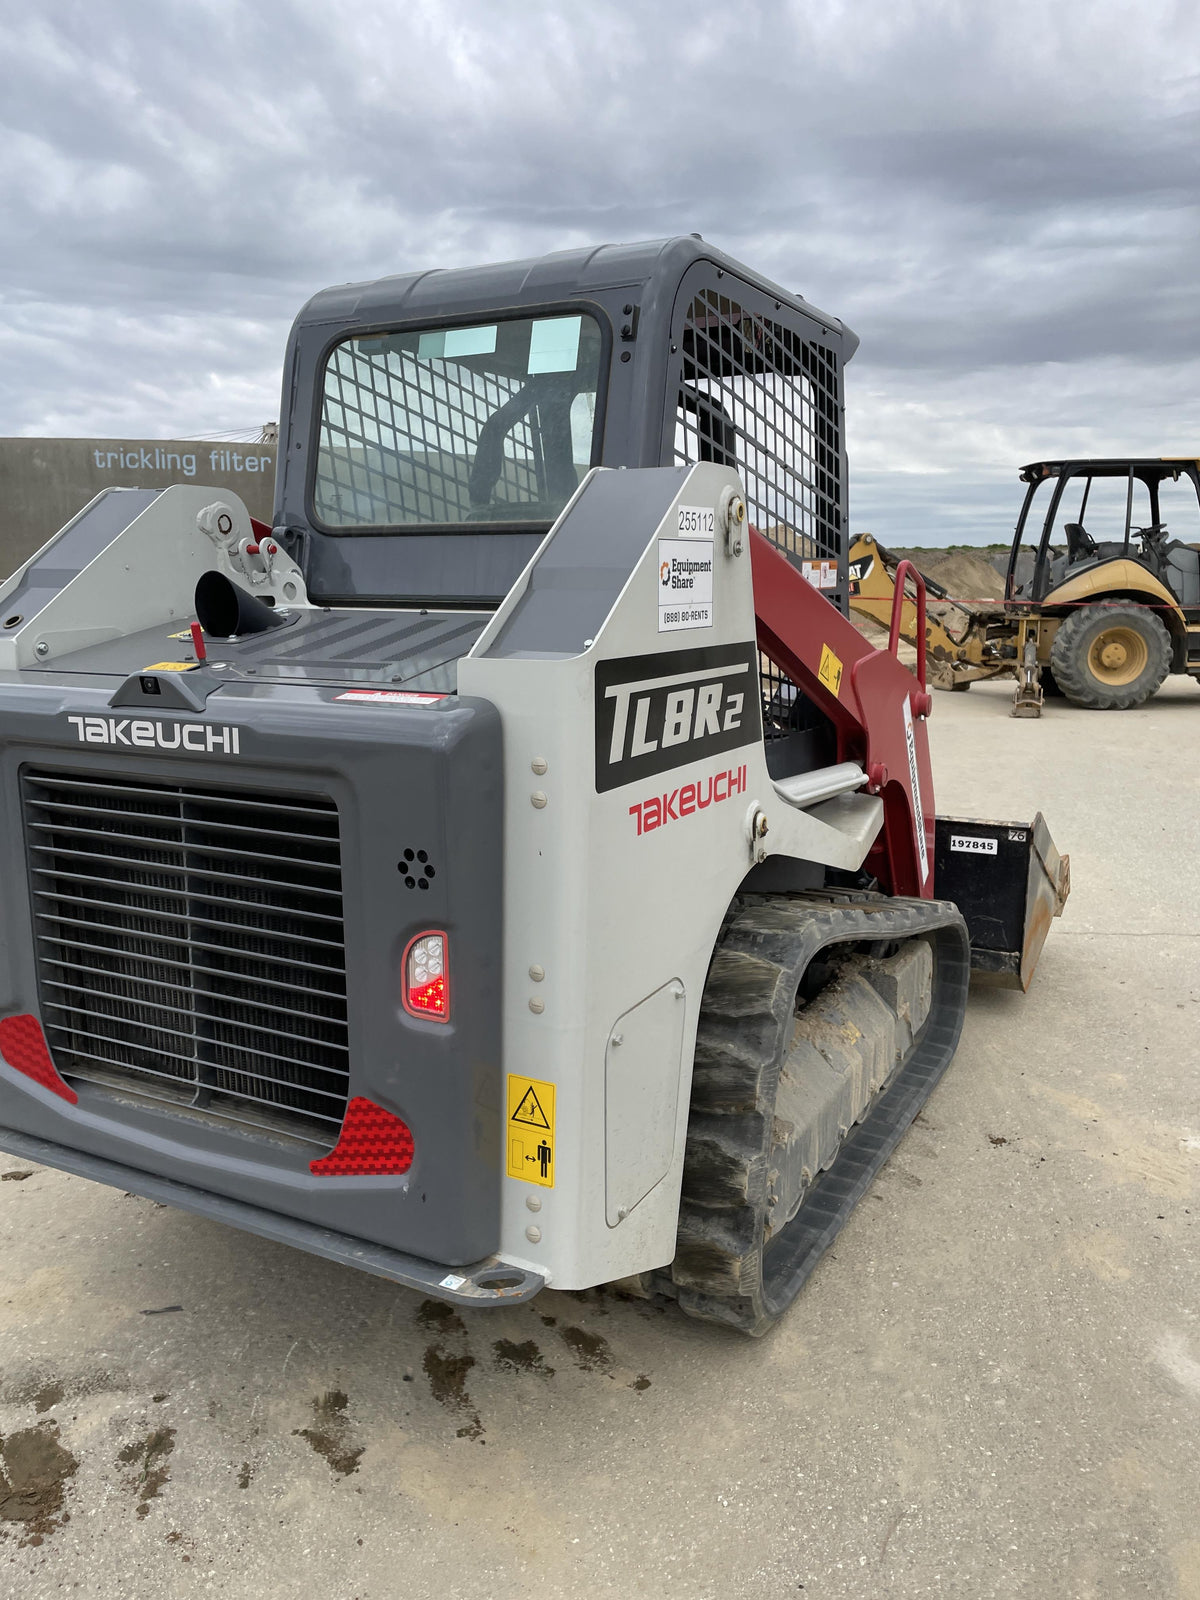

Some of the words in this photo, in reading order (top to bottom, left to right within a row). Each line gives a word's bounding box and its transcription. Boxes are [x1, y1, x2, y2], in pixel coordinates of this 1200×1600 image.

[94, 448, 197, 476] trickling
[209, 450, 272, 472] filter
[679, 511, 713, 531] 255112
[672, 559, 711, 575] Equipment
[849, 564, 861, 580] AT
[672, 575, 693, 589] Share
[604, 663, 749, 764] TL8R2
[68, 716, 240, 755] TAKEUCHI
[629, 765, 747, 836] TAKEUCHI
[1010, 831, 1025, 841] 76
[952, 840, 994, 851] 197845
